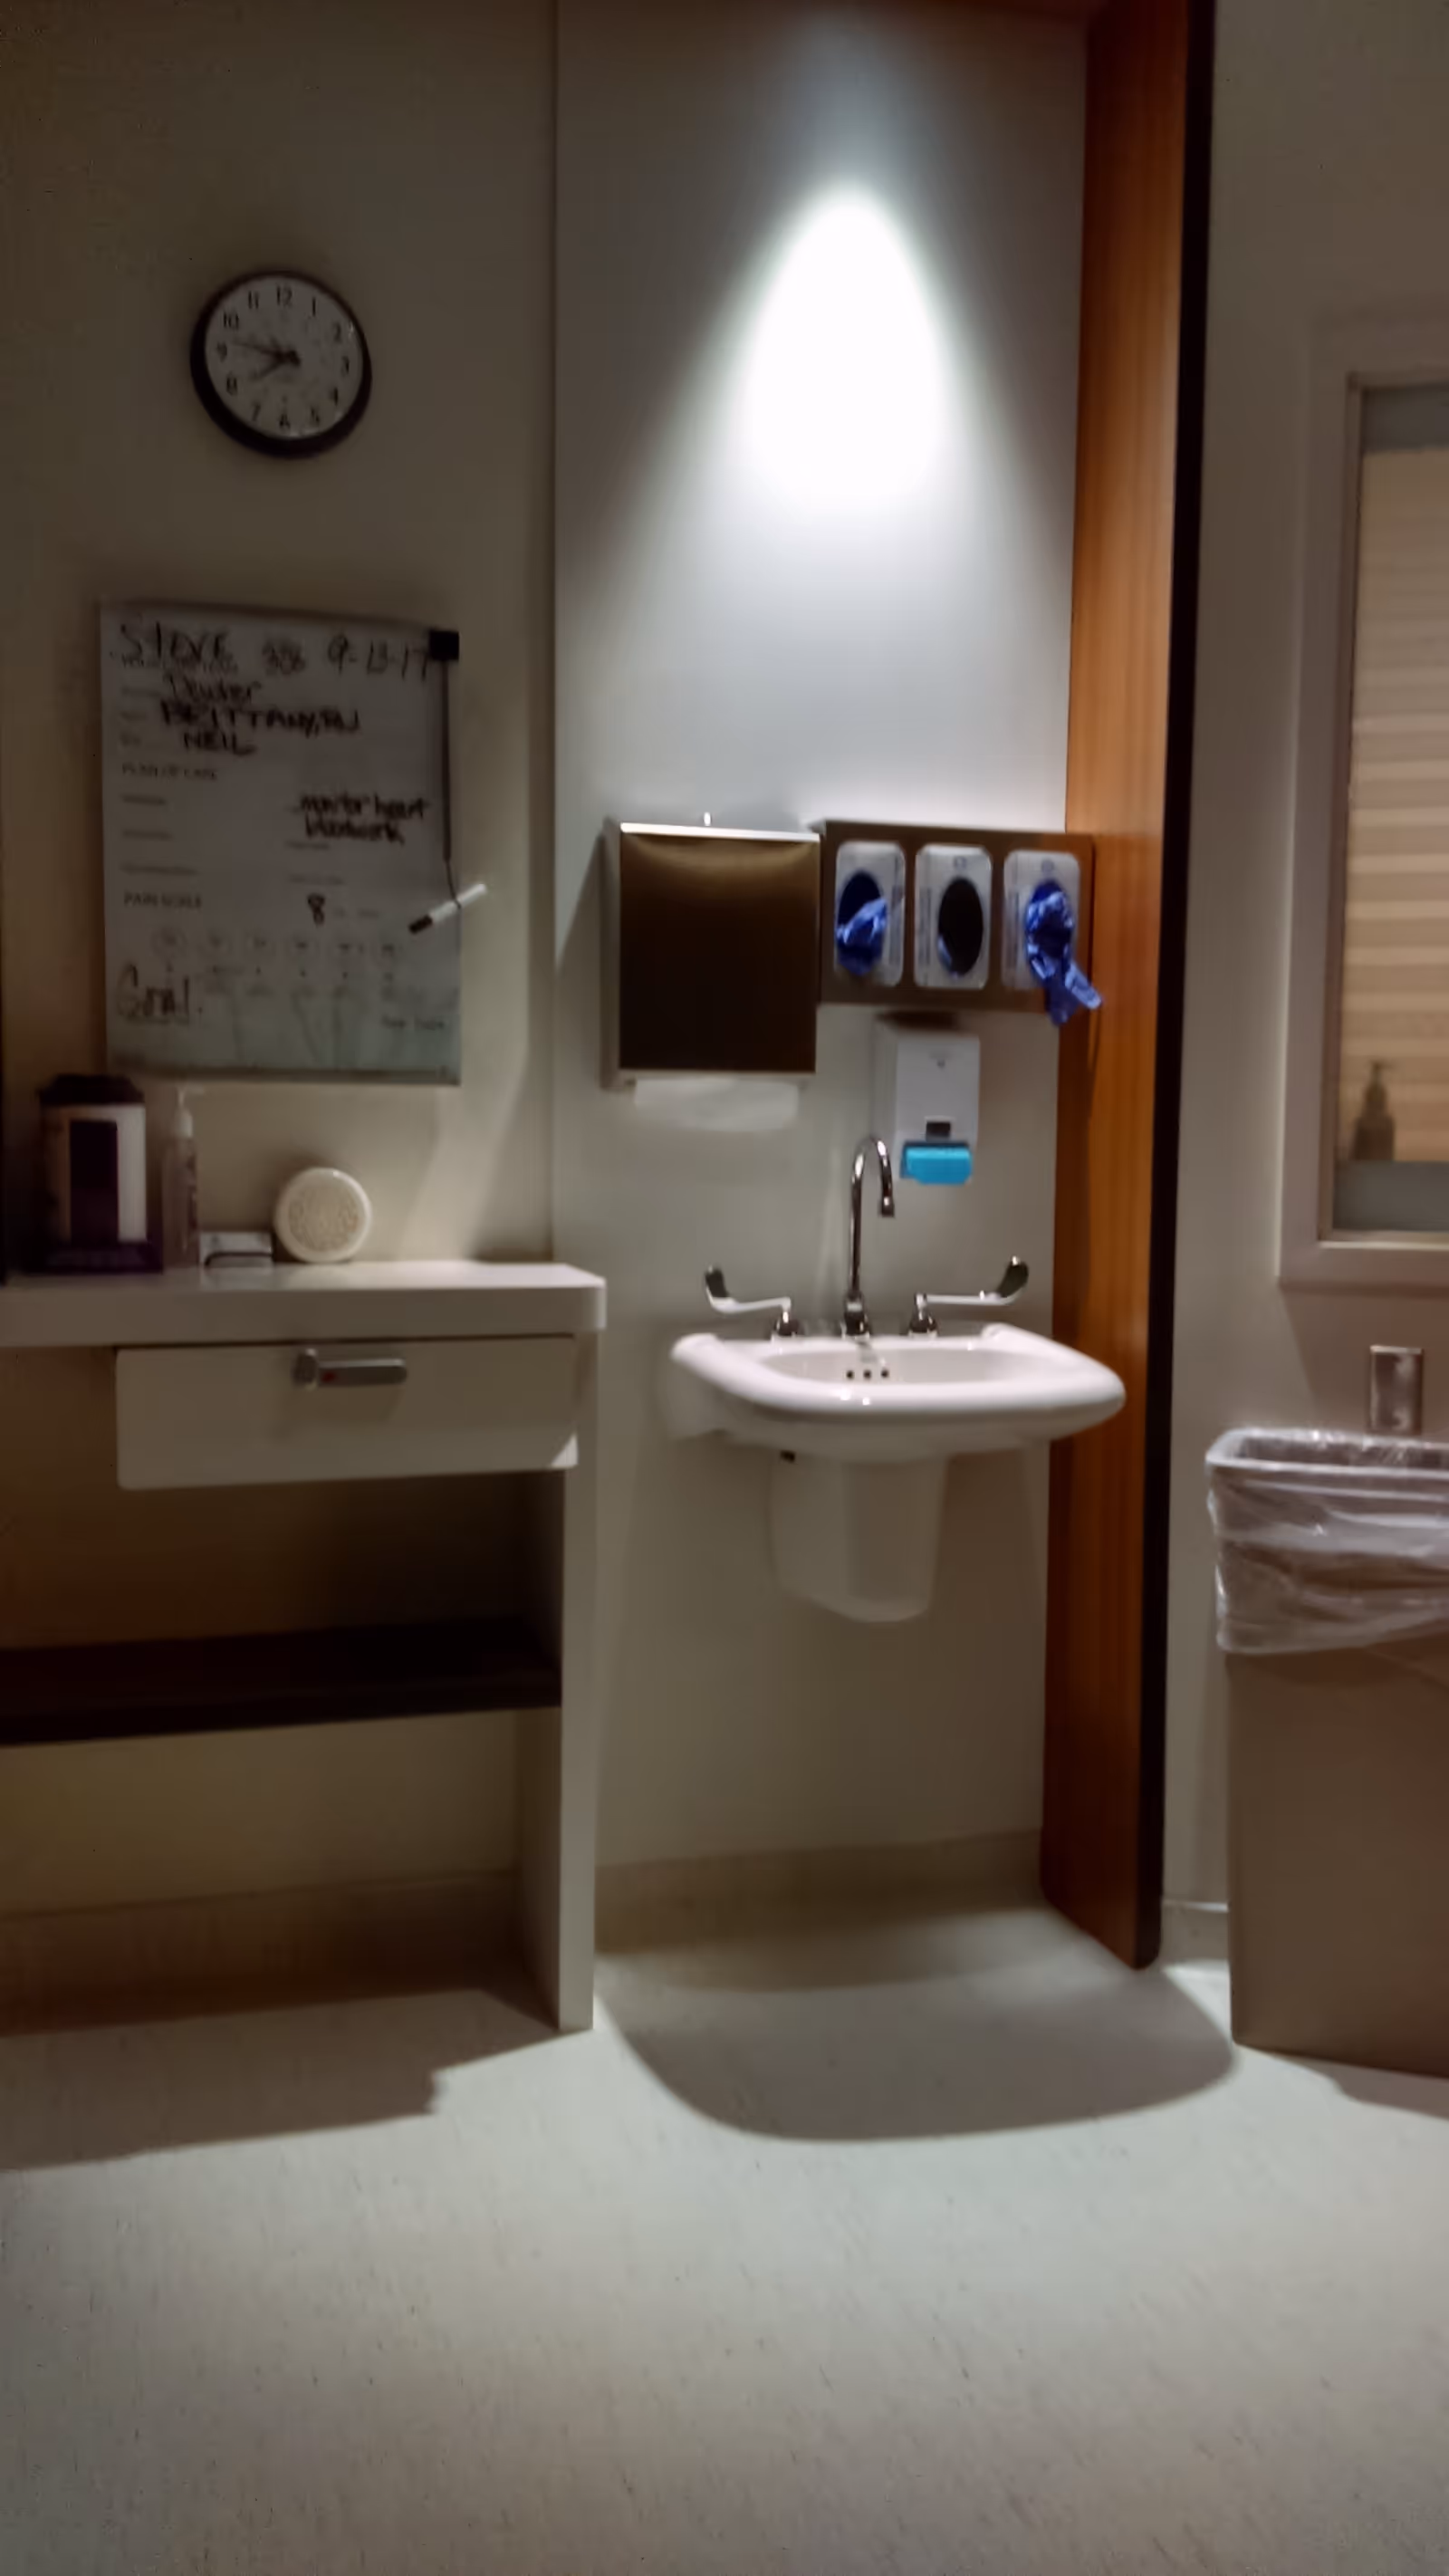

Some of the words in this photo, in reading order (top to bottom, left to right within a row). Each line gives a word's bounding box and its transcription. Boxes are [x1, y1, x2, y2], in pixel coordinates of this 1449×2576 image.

[247, 290, 261, 310] 11
[276, 284, 293, 306] 12
[223, 308, 240, 330] 10
[332, 321, 343, 344] 2
